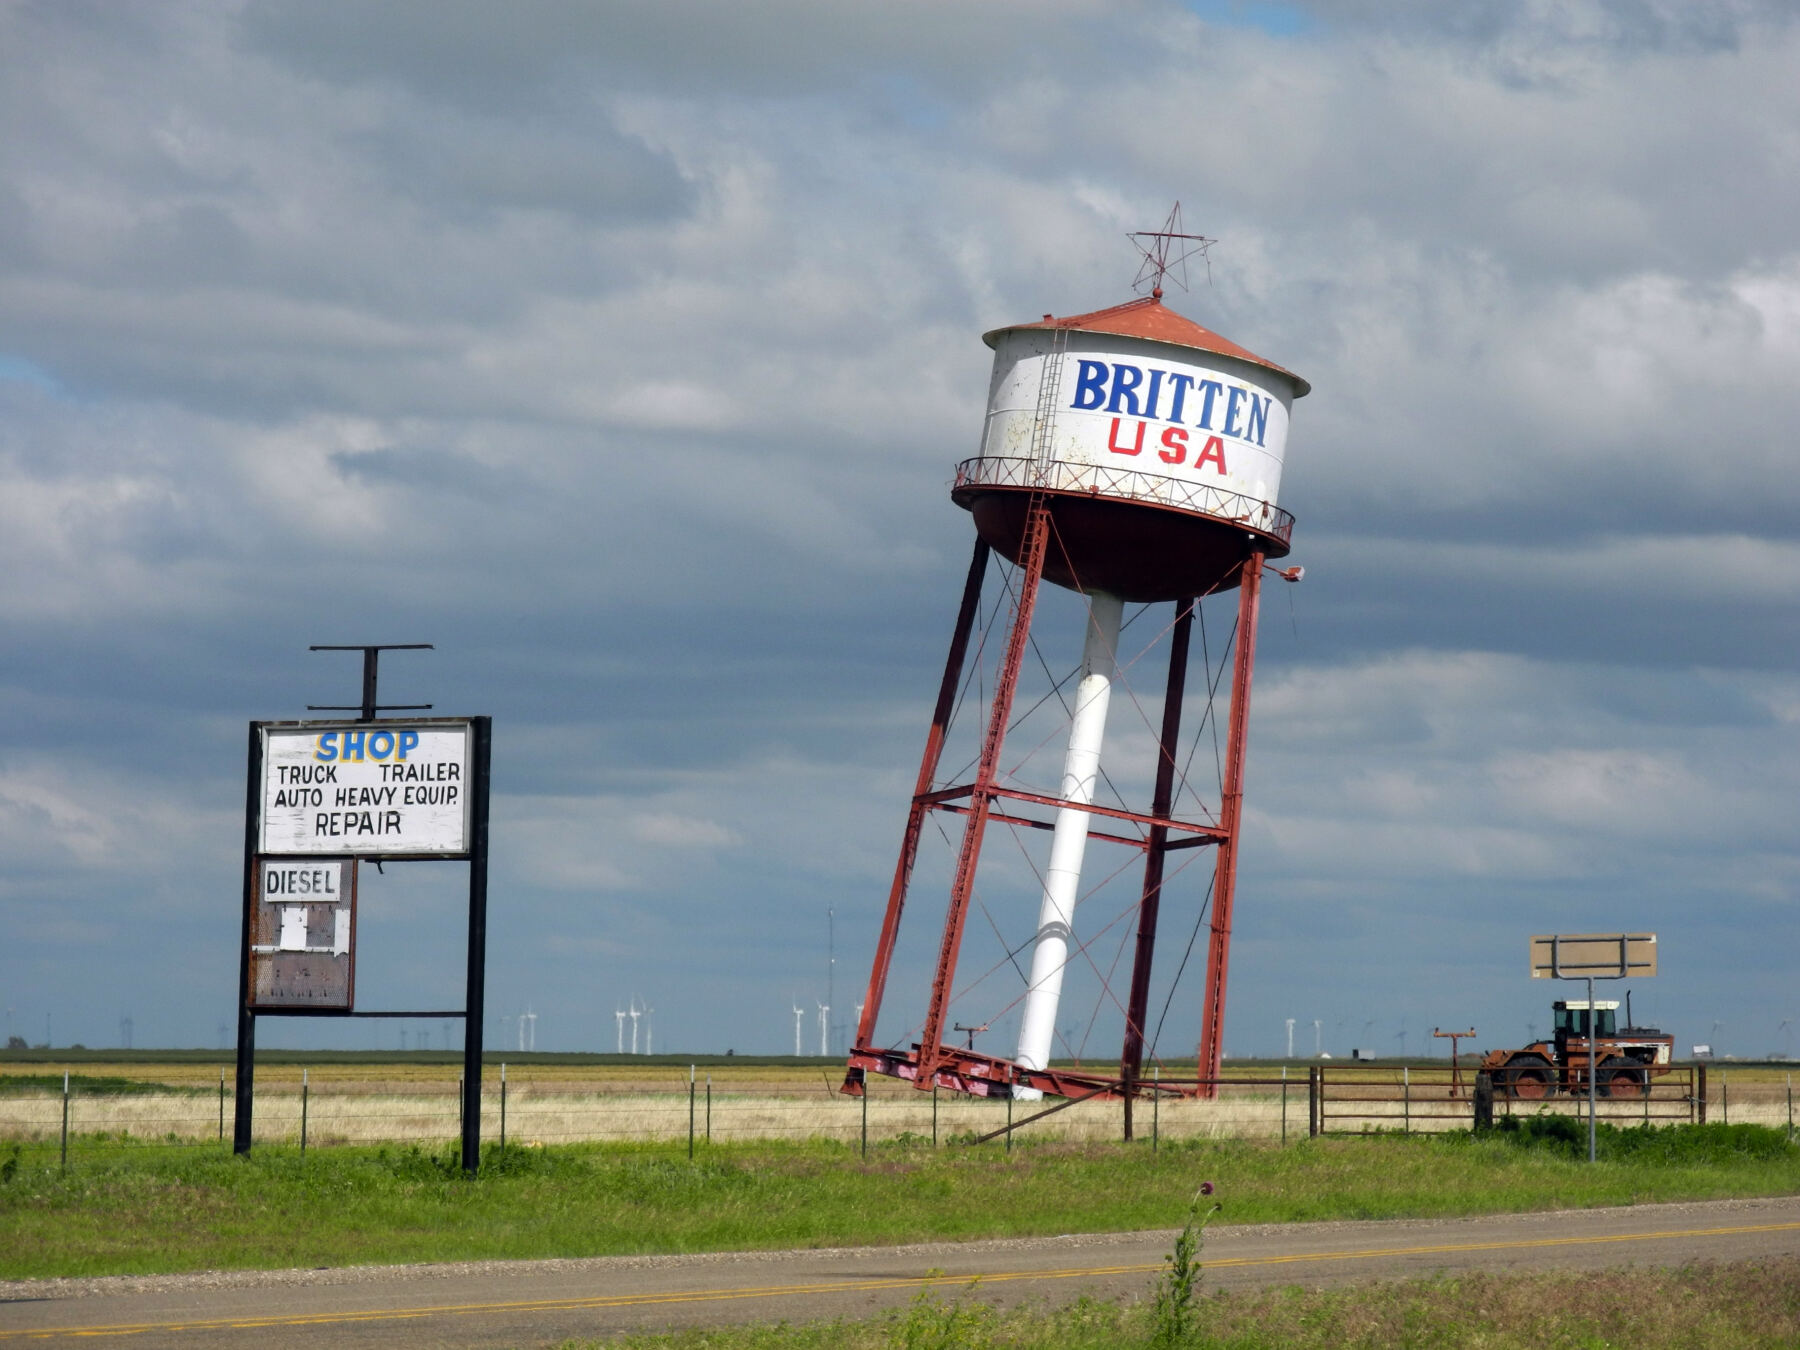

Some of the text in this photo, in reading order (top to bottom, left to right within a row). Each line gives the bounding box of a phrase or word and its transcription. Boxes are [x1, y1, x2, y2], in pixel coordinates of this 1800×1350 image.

[1070, 359, 1273, 448] BRITTEN
[1108, 417, 1227, 476] USA
[313, 730, 419, 763] SHOP
[277, 763, 460, 785] TRUCK TRAILER
[274, 788, 323, 808] AUTO
[335, 787, 397, 807] HEAVY
[315, 811, 401, 836] REPAIR
[266, 870, 335, 894] DIESEL
